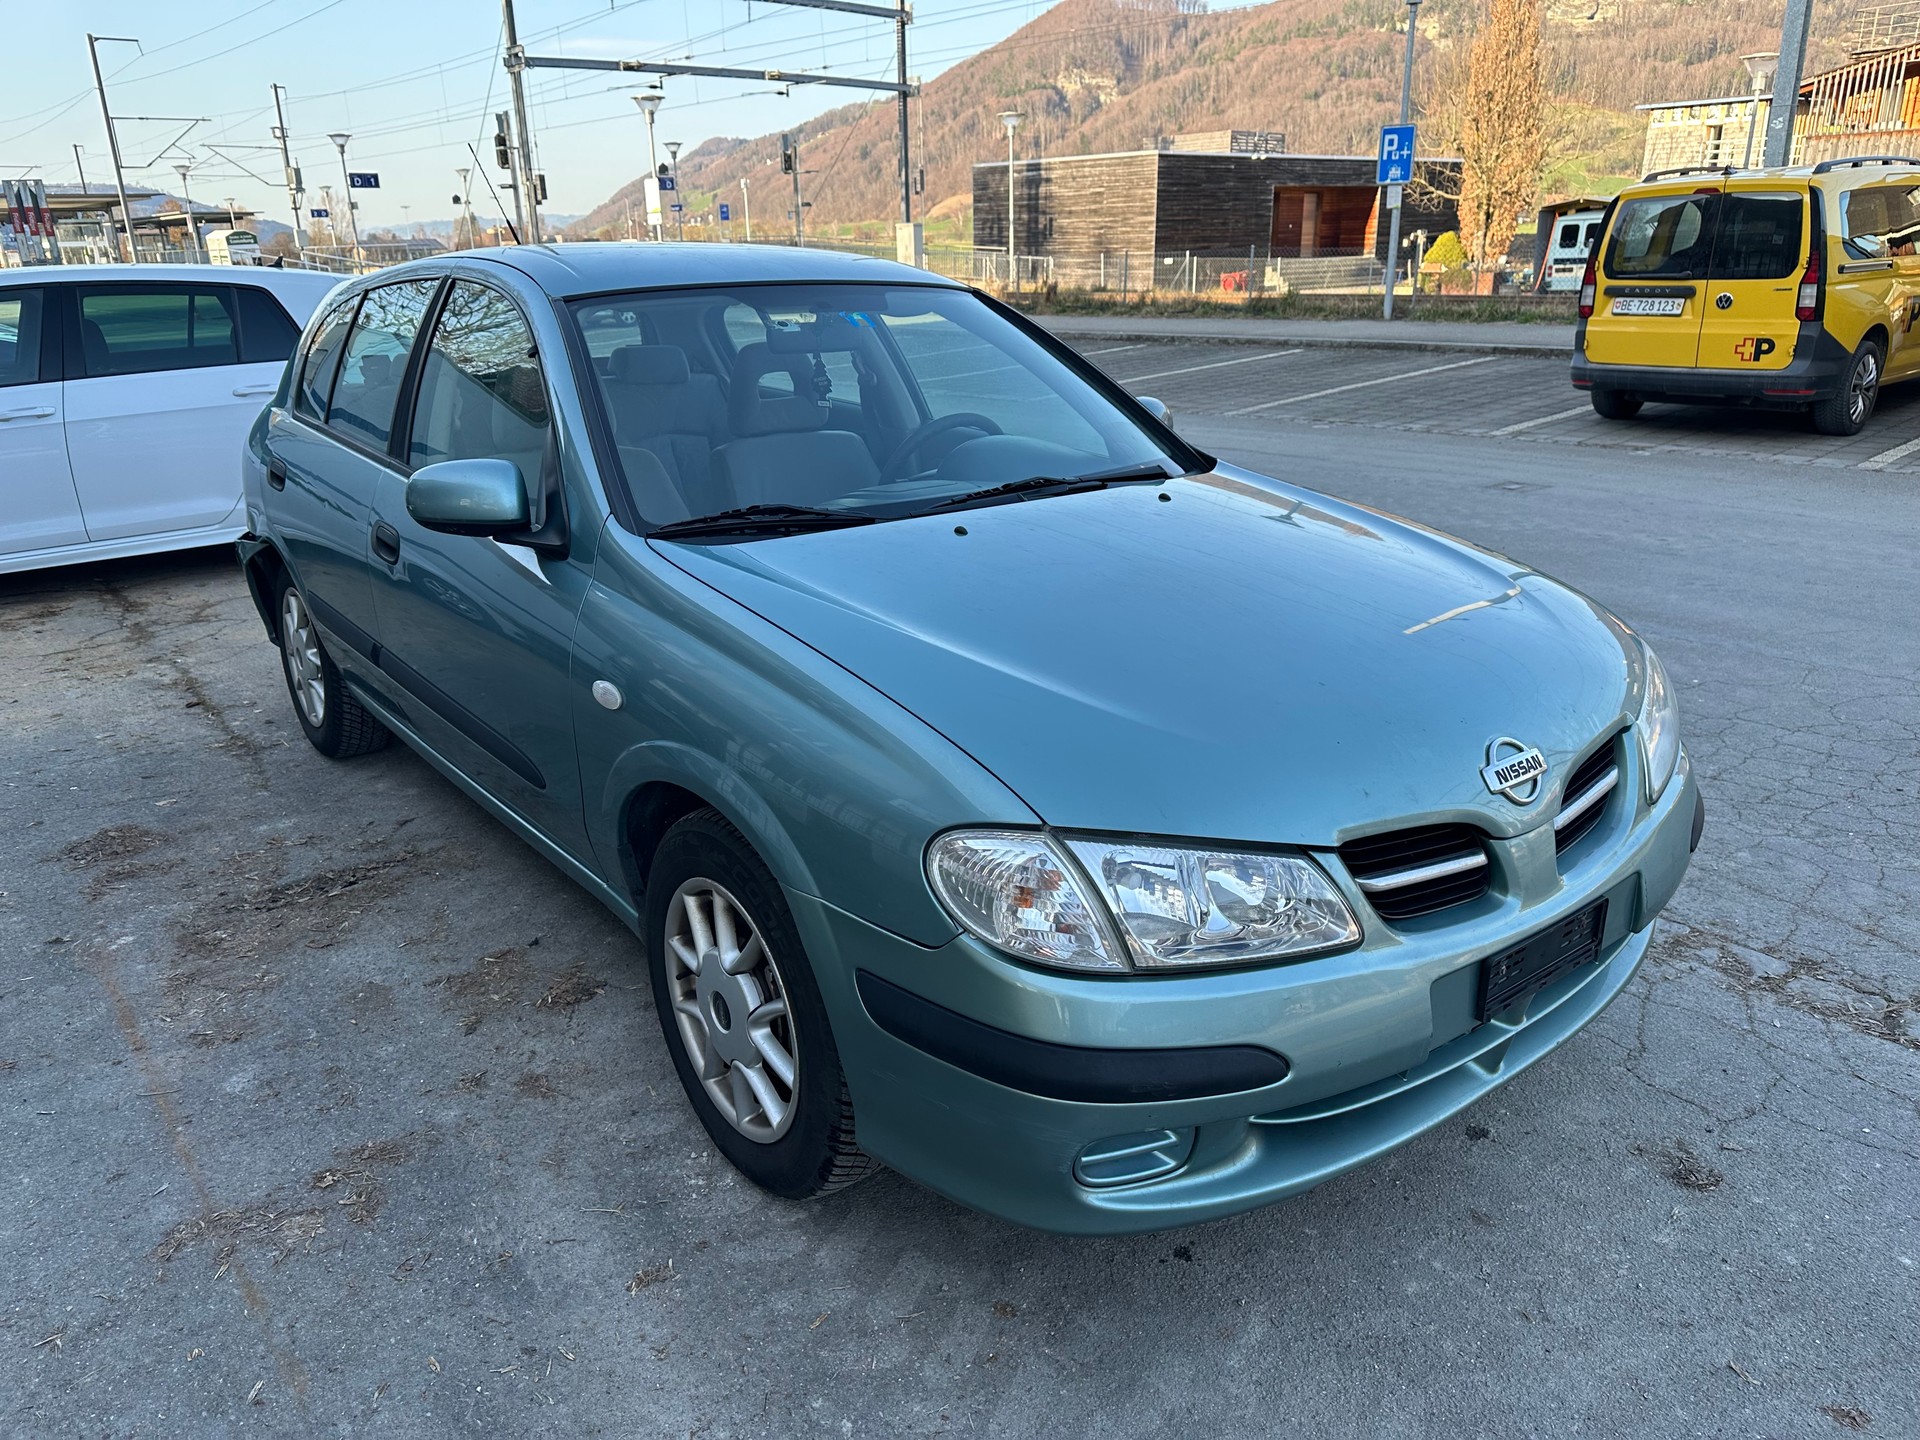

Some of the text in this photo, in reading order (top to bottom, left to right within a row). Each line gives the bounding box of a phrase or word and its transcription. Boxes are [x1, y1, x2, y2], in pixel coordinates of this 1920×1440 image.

[354, 178, 375, 186] D 1
[1494, 754, 1543, 785] NISSAN
